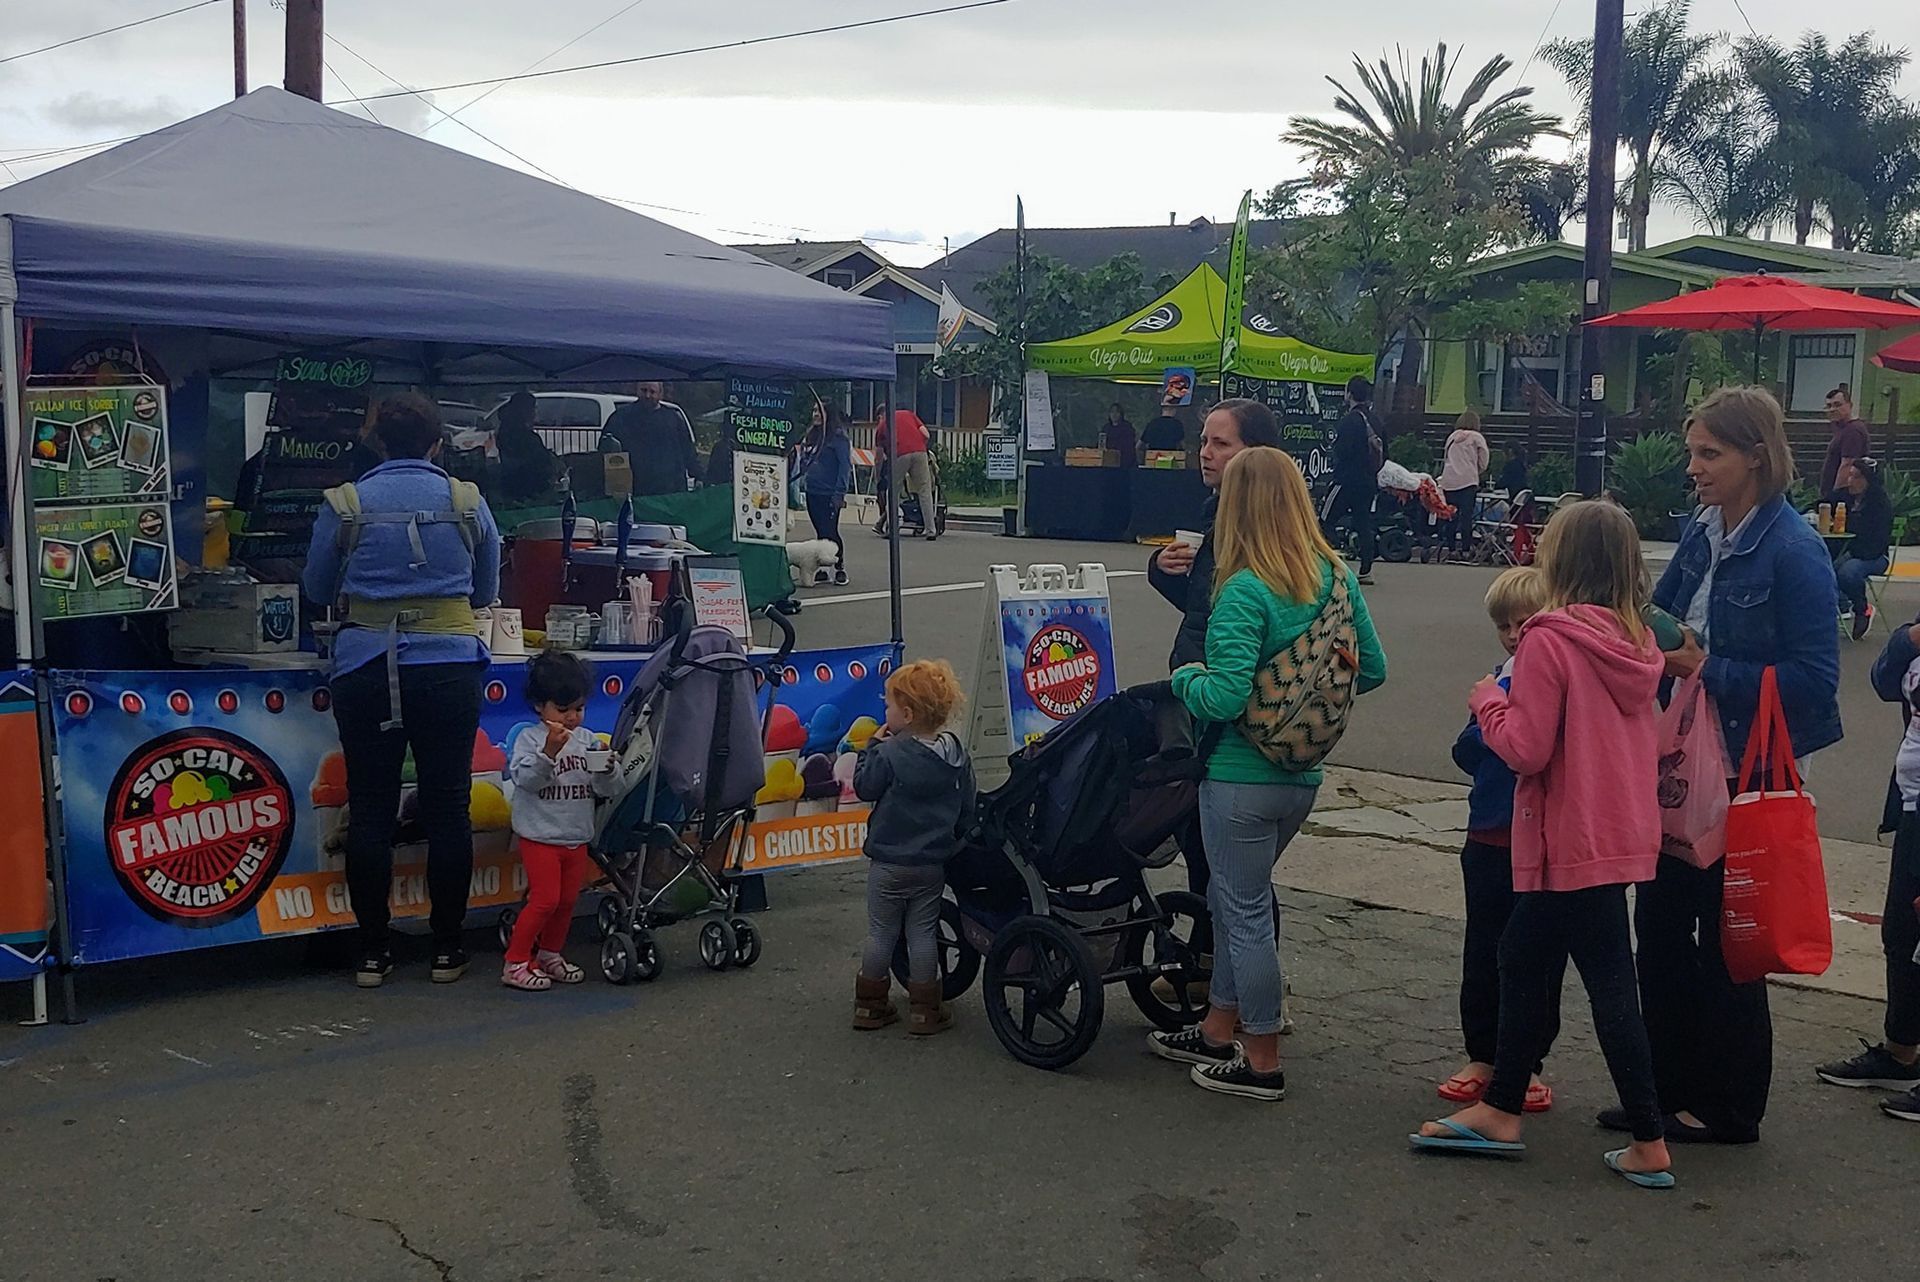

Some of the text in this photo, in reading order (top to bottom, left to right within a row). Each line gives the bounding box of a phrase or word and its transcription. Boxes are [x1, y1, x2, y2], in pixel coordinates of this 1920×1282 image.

[1090, 348, 1128, 371] Veg'n
[1129, 347, 1154, 366] Out
[1310, 354, 1329, 374] Out
[29, 400, 64, 412] TALIAN
[69, 400, 85, 411] ICE
[730, 412, 792, 433] FRESH BREWED
[280, 437, 341, 460] MANGO
[736, 427, 786, 449] GINGER ALE
[989, 443, 1001, 452] NO
[265, 504, 298, 513] SUPER
[263, 600, 292, 616] WATER
[1032, 630, 1079, 657] SO CAL
[1026, 655, 1098, 692] FAMOUS
[1039, 679, 1096, 716] BEACH ICE
[132, 747, 248, 800] SO CAL
[538, 785, 593, 801] UNIVERS
[117, 793, 281, 866] FAMOUS
[765, 822, 868, 860] CHOLESTER
[145, 841, 270, 908] BEACH ICE
[275, 885, 315, 921] NO
[469, 865, 501, 898] NO
